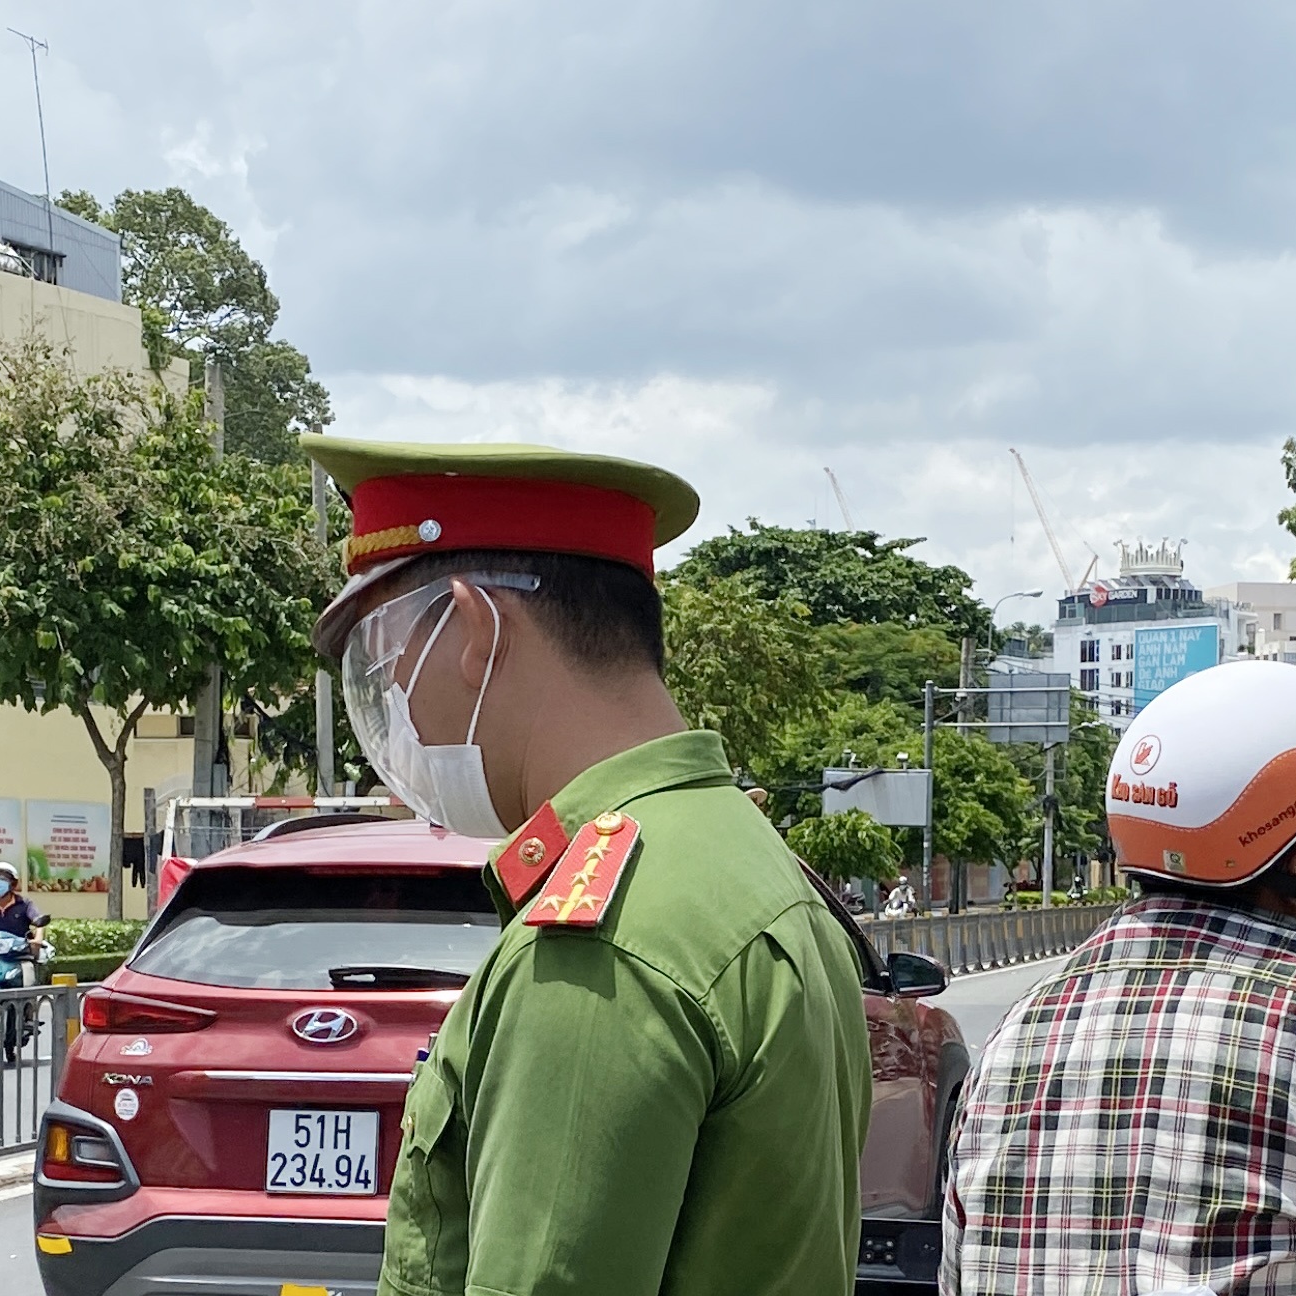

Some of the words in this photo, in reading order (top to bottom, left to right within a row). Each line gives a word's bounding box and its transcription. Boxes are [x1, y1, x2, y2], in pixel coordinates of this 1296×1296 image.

[1108, 589, 1137, 601] GARDEN
[101, 1072, 153, 1086] KONA
[294, 1113, 351, 1150] 51H
[270, 1152, 371, 1189] 234.94
